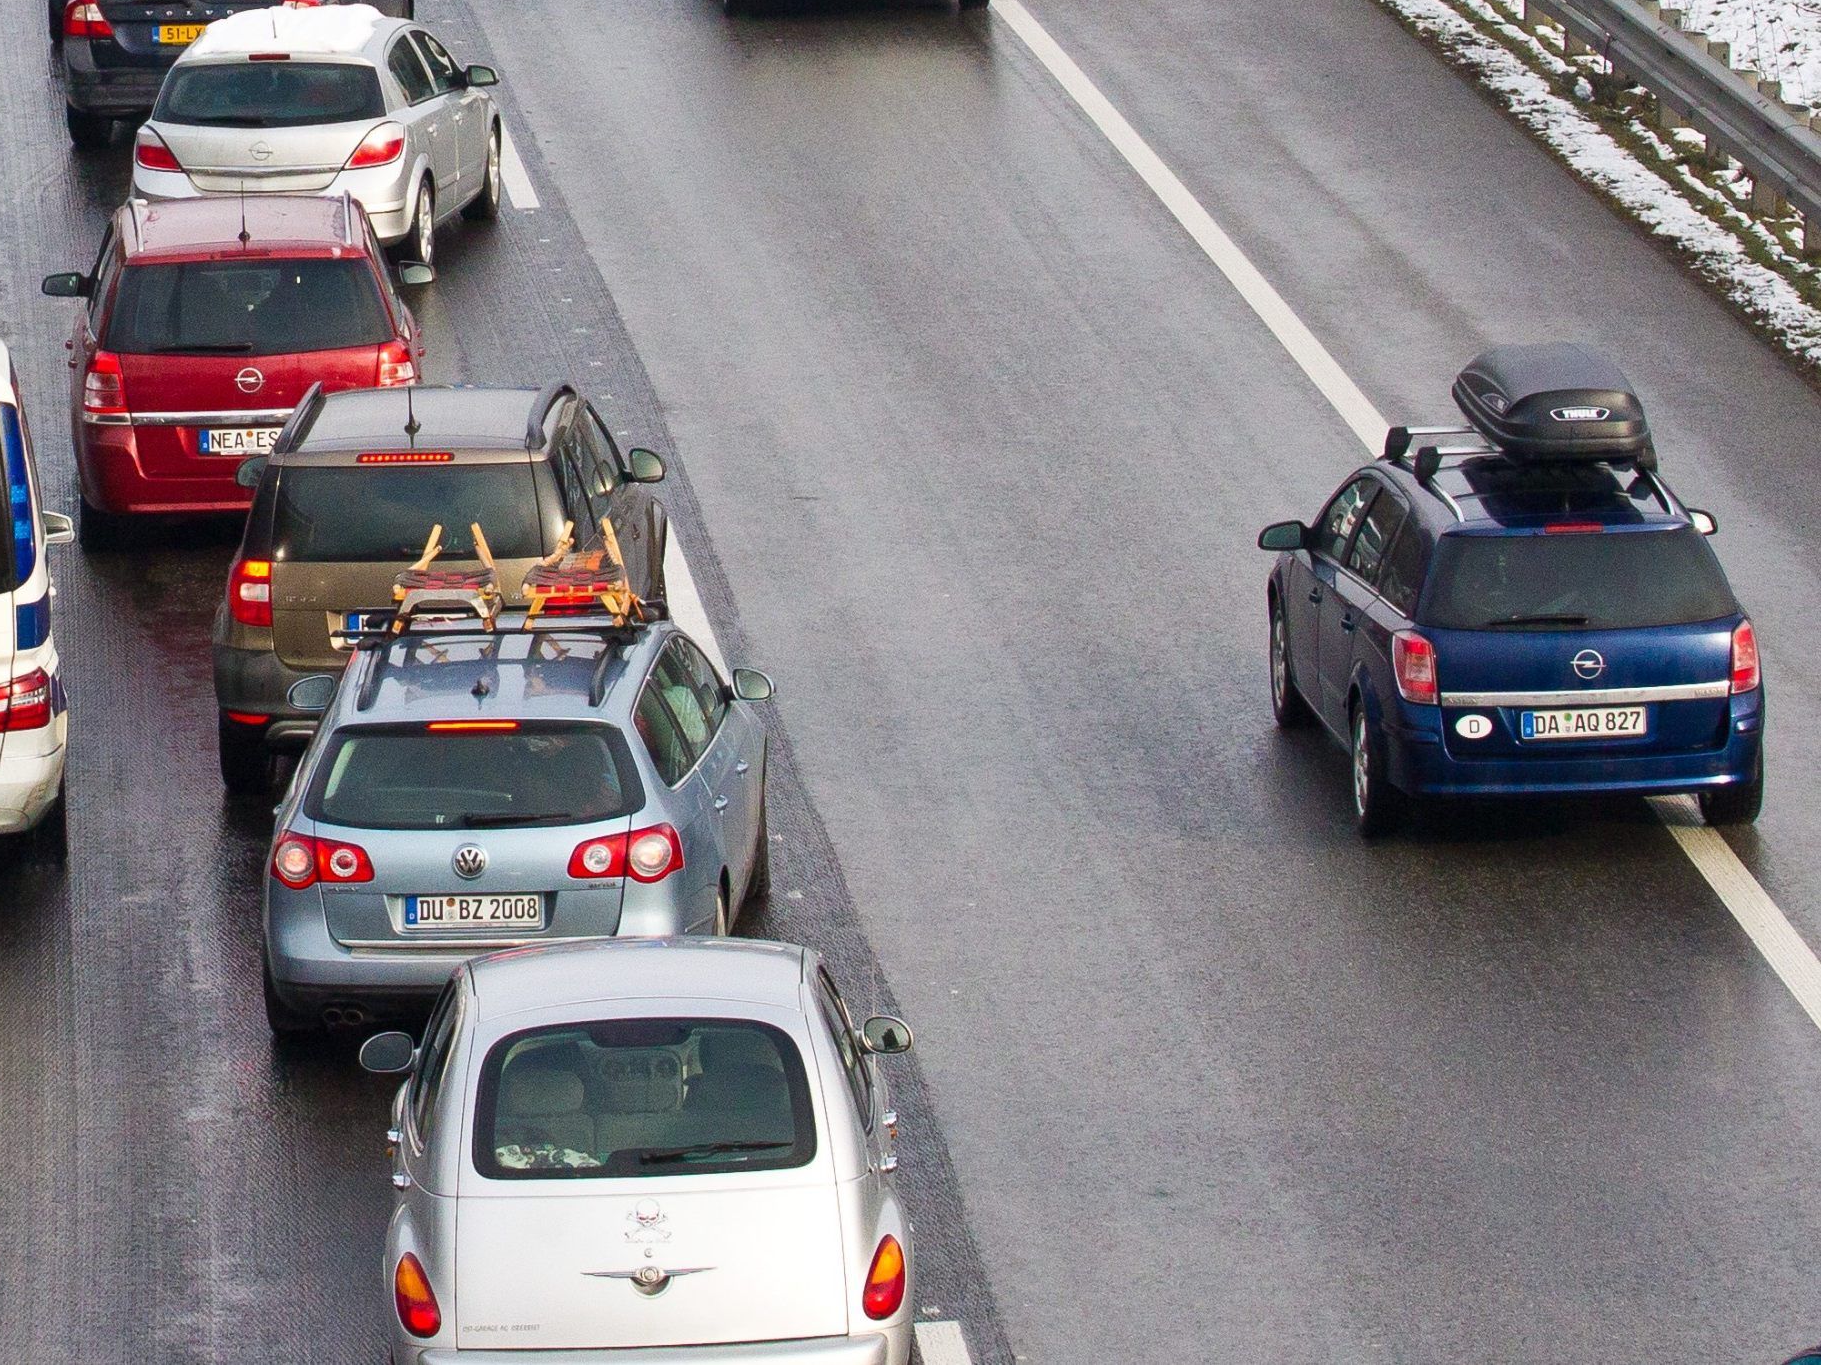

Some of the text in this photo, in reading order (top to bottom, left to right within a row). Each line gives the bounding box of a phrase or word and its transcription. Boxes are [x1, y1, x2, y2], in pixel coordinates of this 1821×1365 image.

[211, 433, 244, 449] NEA
[1469, 720, 1480, 734] D
[1534, 711, 1641, 734] DA AQ 827
[419, 898, 537, 921] DU BZ 2008
